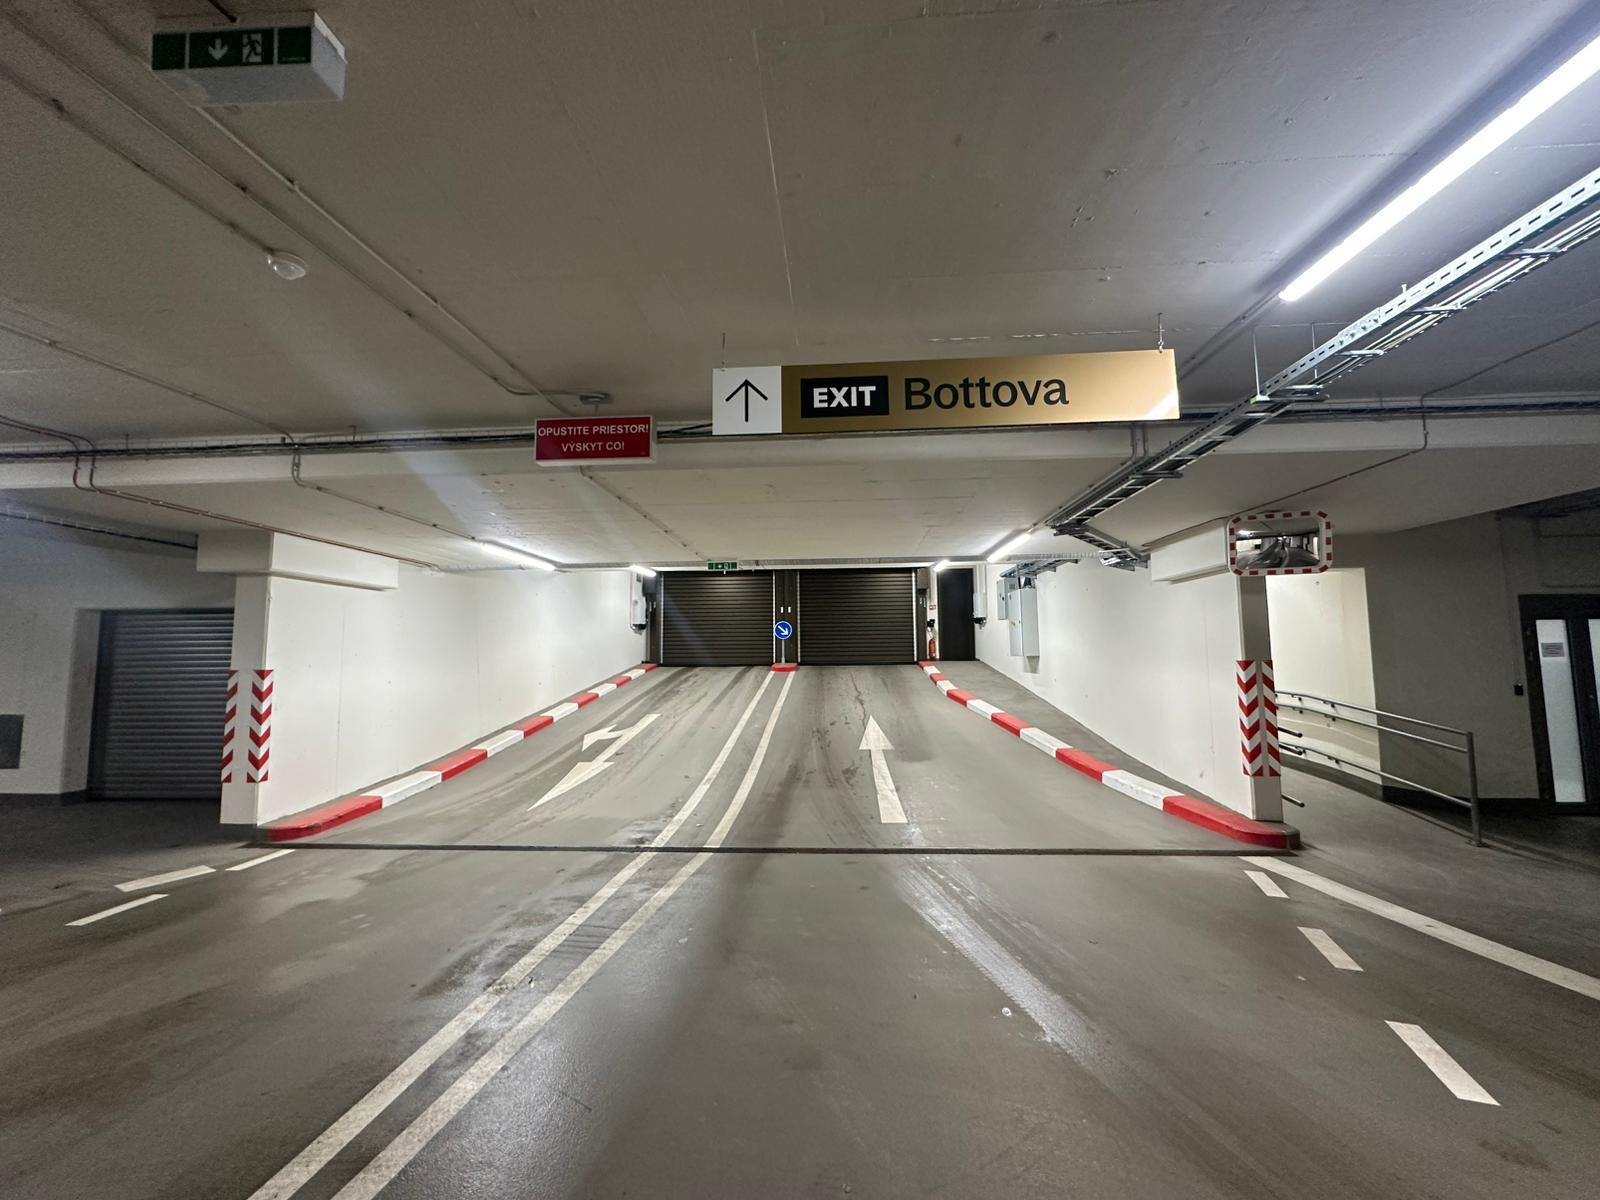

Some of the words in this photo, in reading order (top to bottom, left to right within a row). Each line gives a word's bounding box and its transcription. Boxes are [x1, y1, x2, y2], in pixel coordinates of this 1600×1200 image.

[813, 385, 876, 408] EXIT
[904, 376, 1069, 410] Bottova
[538, 426, 590, 436] OPUSTITE
[593, 424, 649, 434] PRIESTOR!
[562, 441, 603, 452] VÝSKYT
[606, 441, 625, 451] CO!
